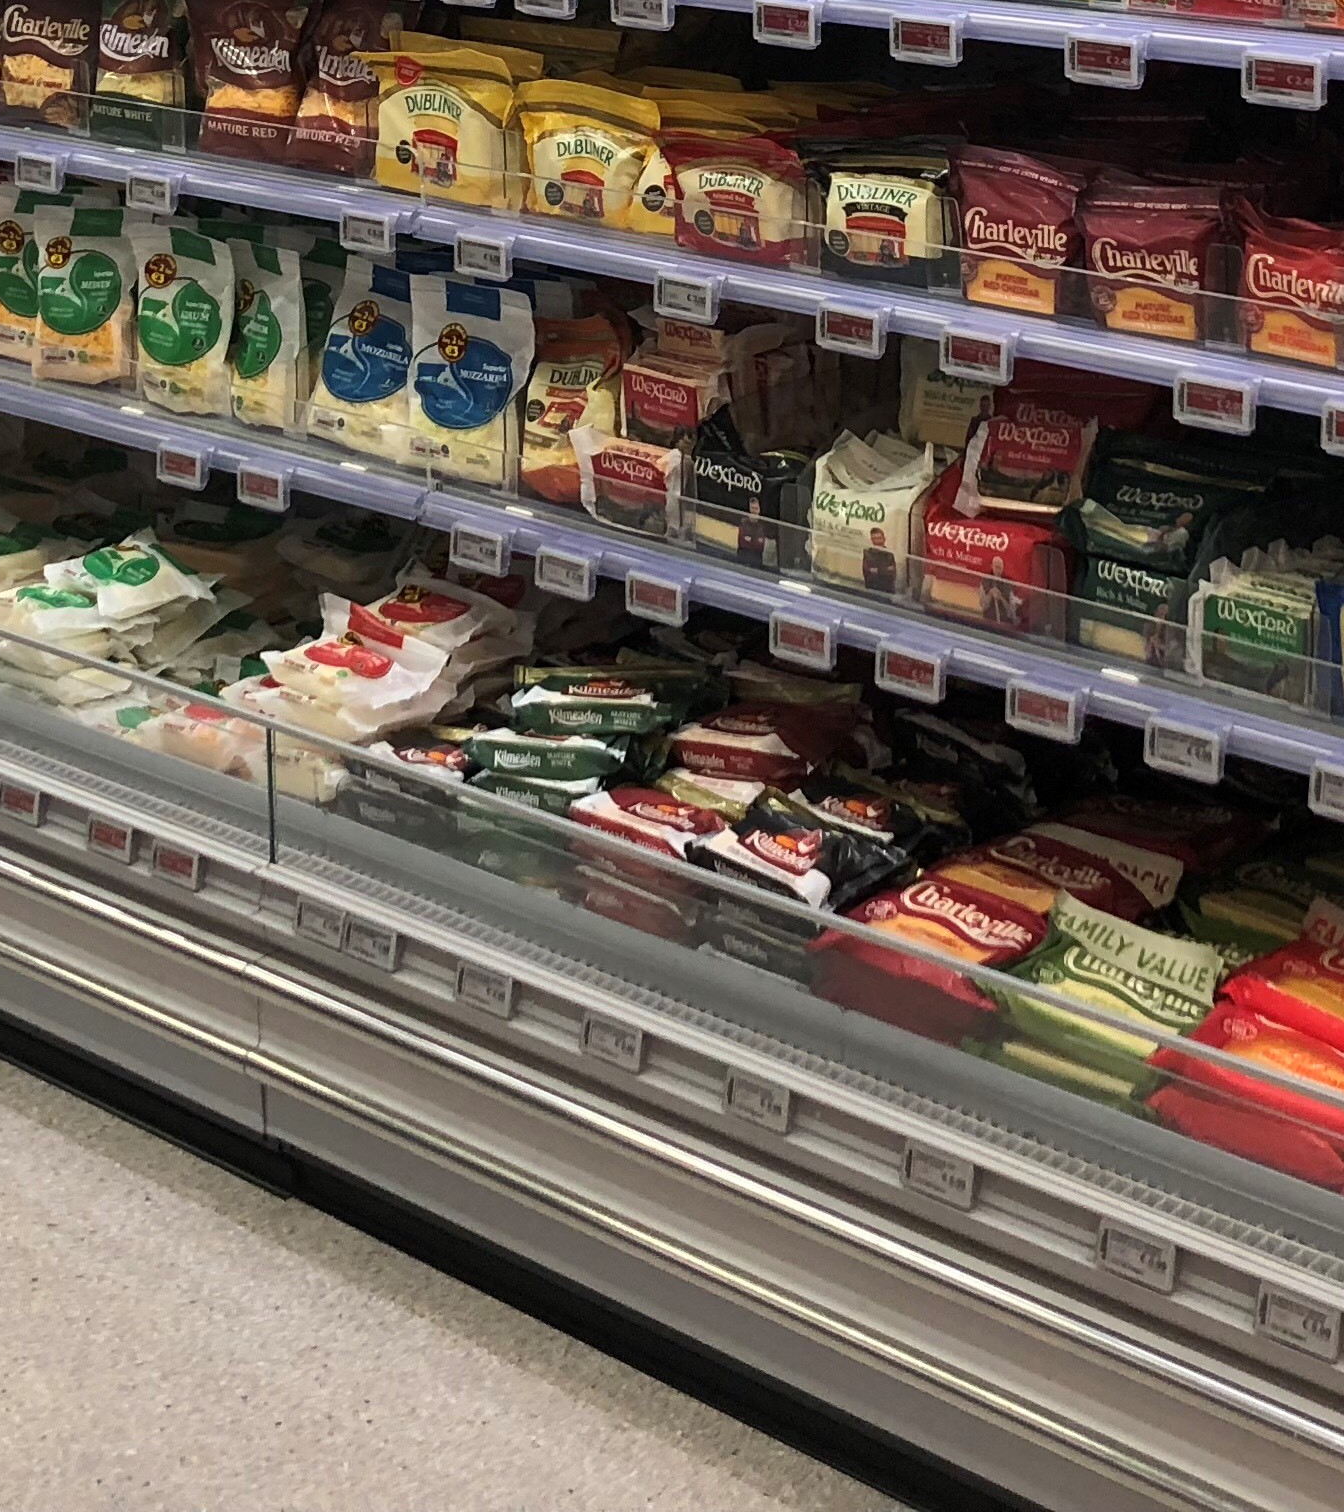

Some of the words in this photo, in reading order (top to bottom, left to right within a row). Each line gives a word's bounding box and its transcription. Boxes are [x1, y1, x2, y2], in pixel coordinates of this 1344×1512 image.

[3, 4, 90, 56] Charleville
[207, 122, 247, 134] MATURE
[252, 127, 278, 138] RED
[404, 94, 464, 120] DUBLINER
[965, 208, 1067, 266] Charleville
[1093, 238, 1200, 288] Charleville
[1136, 945, 1209, 993] VALUE
